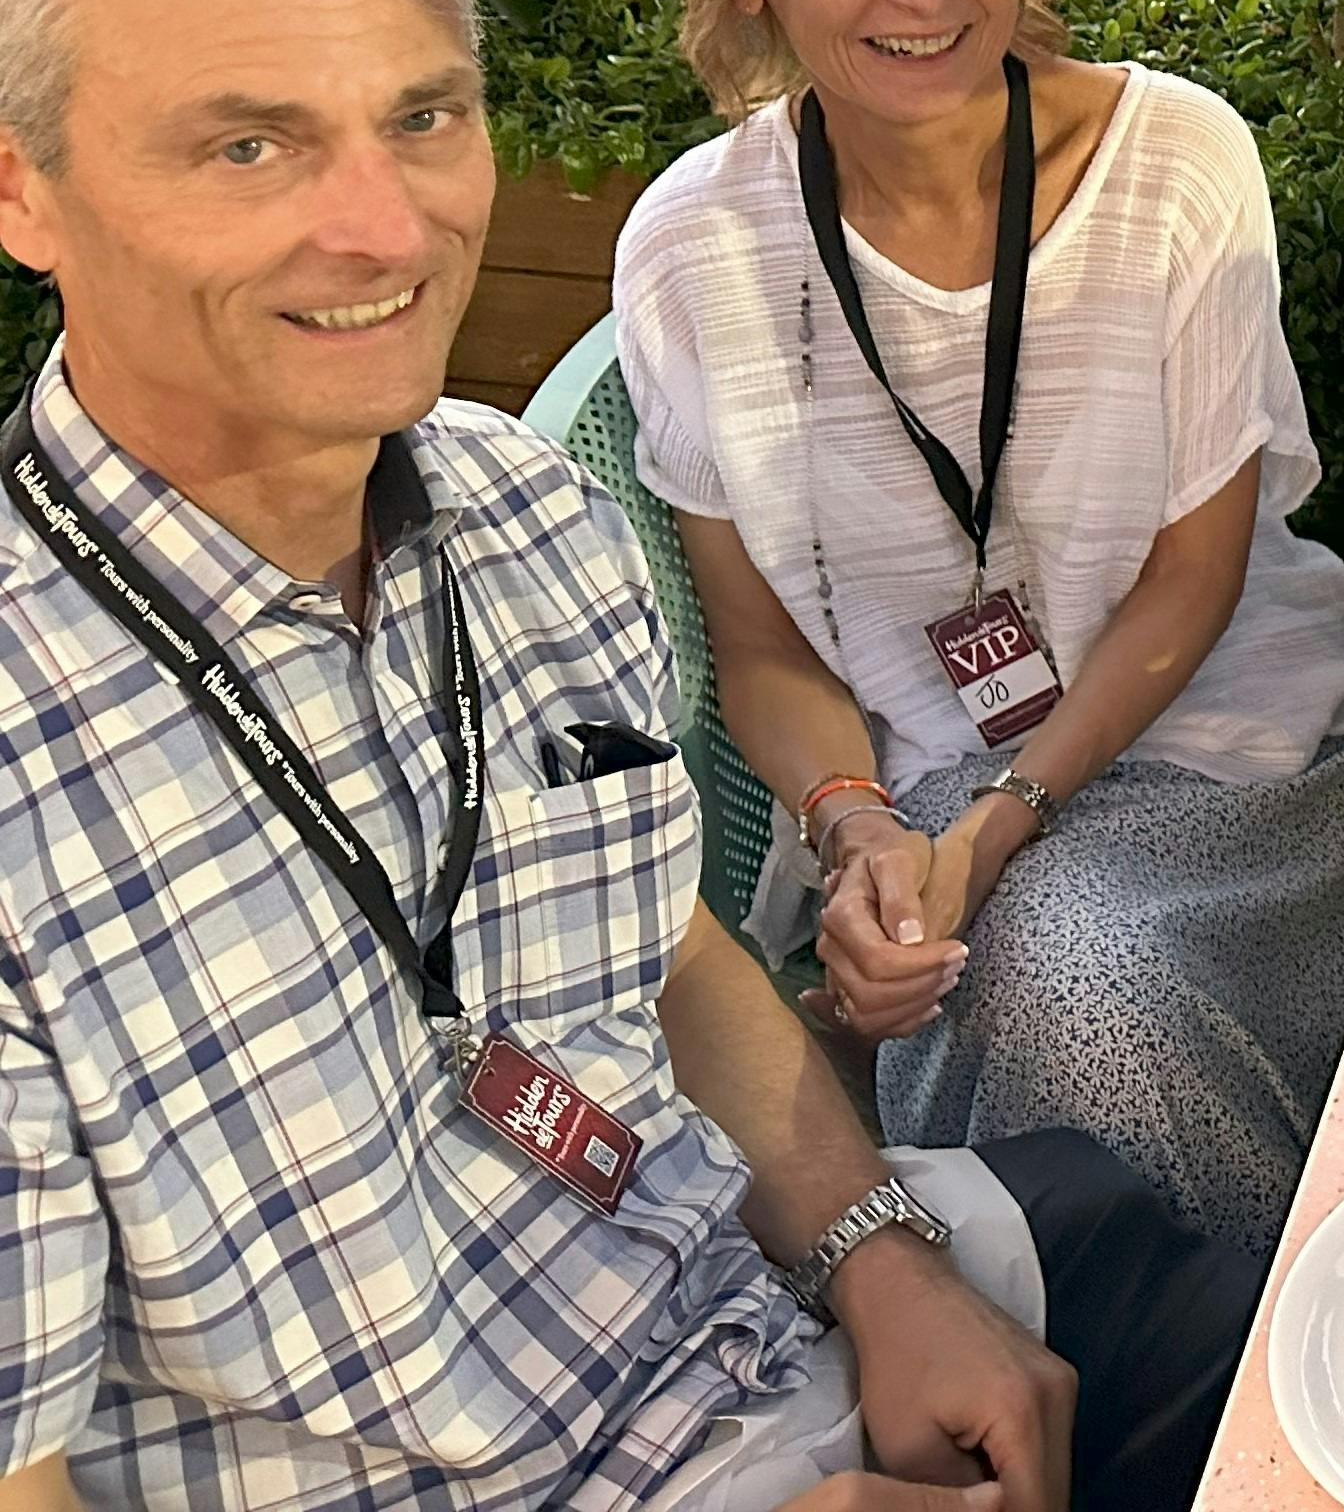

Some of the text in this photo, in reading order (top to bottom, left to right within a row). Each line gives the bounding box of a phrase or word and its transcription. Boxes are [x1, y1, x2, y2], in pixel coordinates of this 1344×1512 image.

[126, 587, 151, 616] with
[143, 609, 199, 664] personality
[948, 625, 1019, 675] VIP
[304, 792, 322, 818] with
[318, 813, 360, 864] personality
[502, 1075, 549, 1135] Hidden
